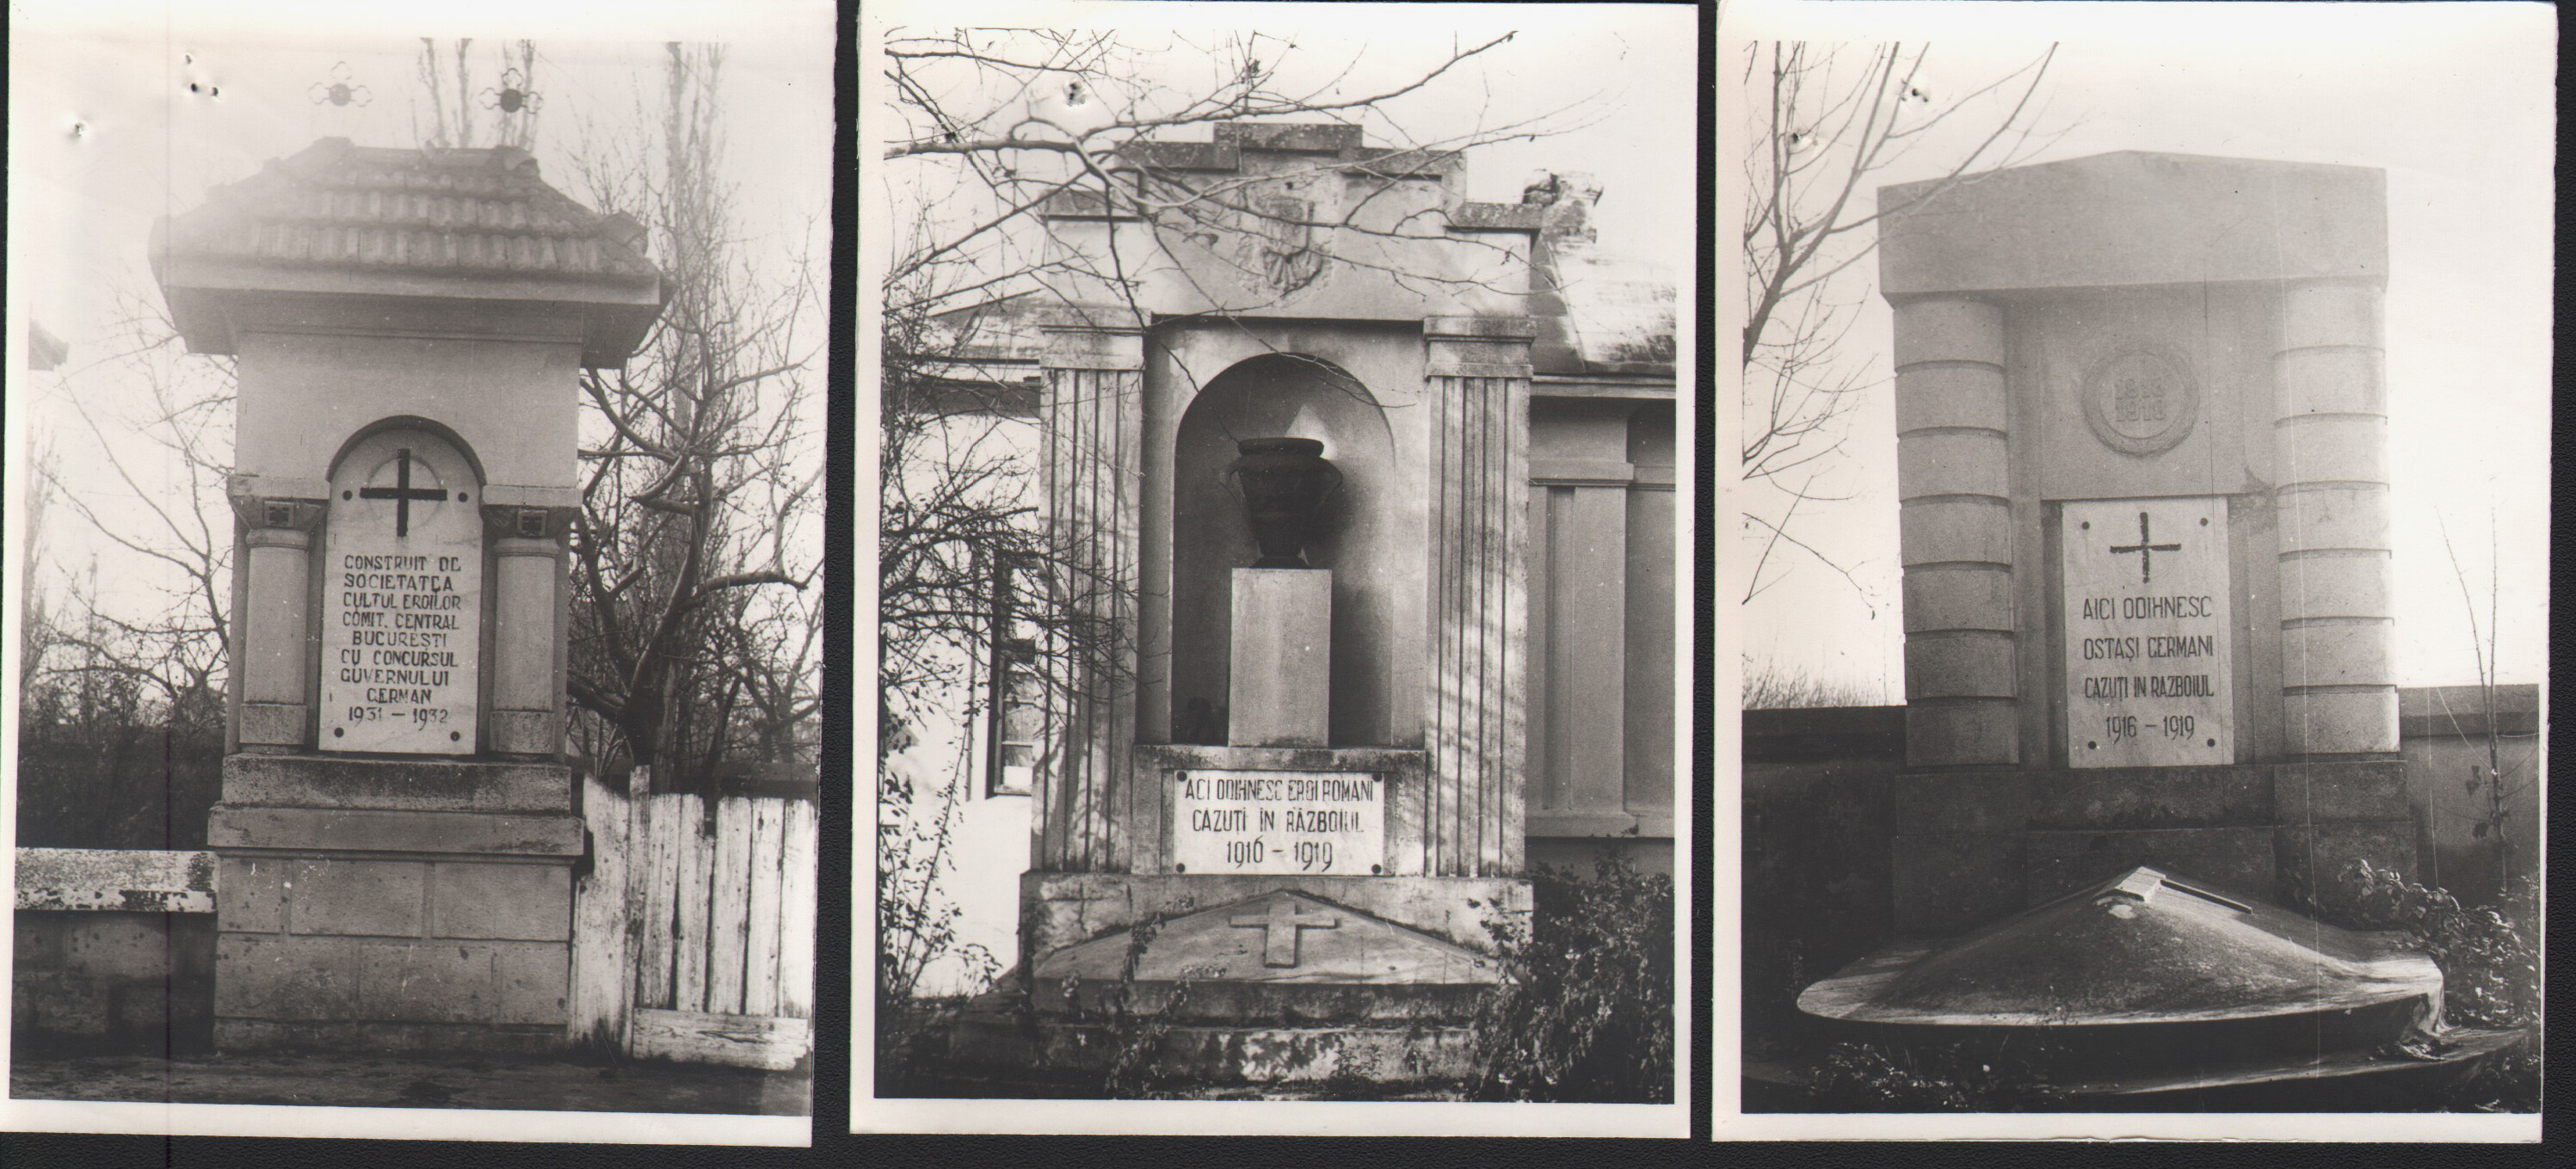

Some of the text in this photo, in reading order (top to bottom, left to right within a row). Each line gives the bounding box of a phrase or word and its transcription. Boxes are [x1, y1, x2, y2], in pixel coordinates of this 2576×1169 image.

[344, 555, 461, 572] CONSTRUIT DE
[342, 591, 462, 611] CULTUL EROILOR
[2083, 595, 2212, 620] AICI ODIHNESC
[342, 611, 459, 631] COMIT. CENTRAL
[2147, 635, 2214, 658] GERMANI
[341, 649, 459, 668] CU CONCURSUL
[340, 668, 449, 686] GUVERNULUI
[2133, 675, 2147, 698] IN
[2150, 674, 2215, 698] RAZBOIUL
[367, 687, 432, 704] GERMAN
[348, 705, 383, 727] 1931
[412, 707, 449, 731] 1932
[2105, 715, 2137, 745] 1916
[2162, 715, 2195, 741] 1919
[1217, 778, 1284, 802] ODIHNESC
[1287, 779, 1318, 802] EROI
[1322, 779, 1374, 802] ROMANI
[1226, 834, 1264, 869] 1916
[1293, 840, 1334, 873] 1919
